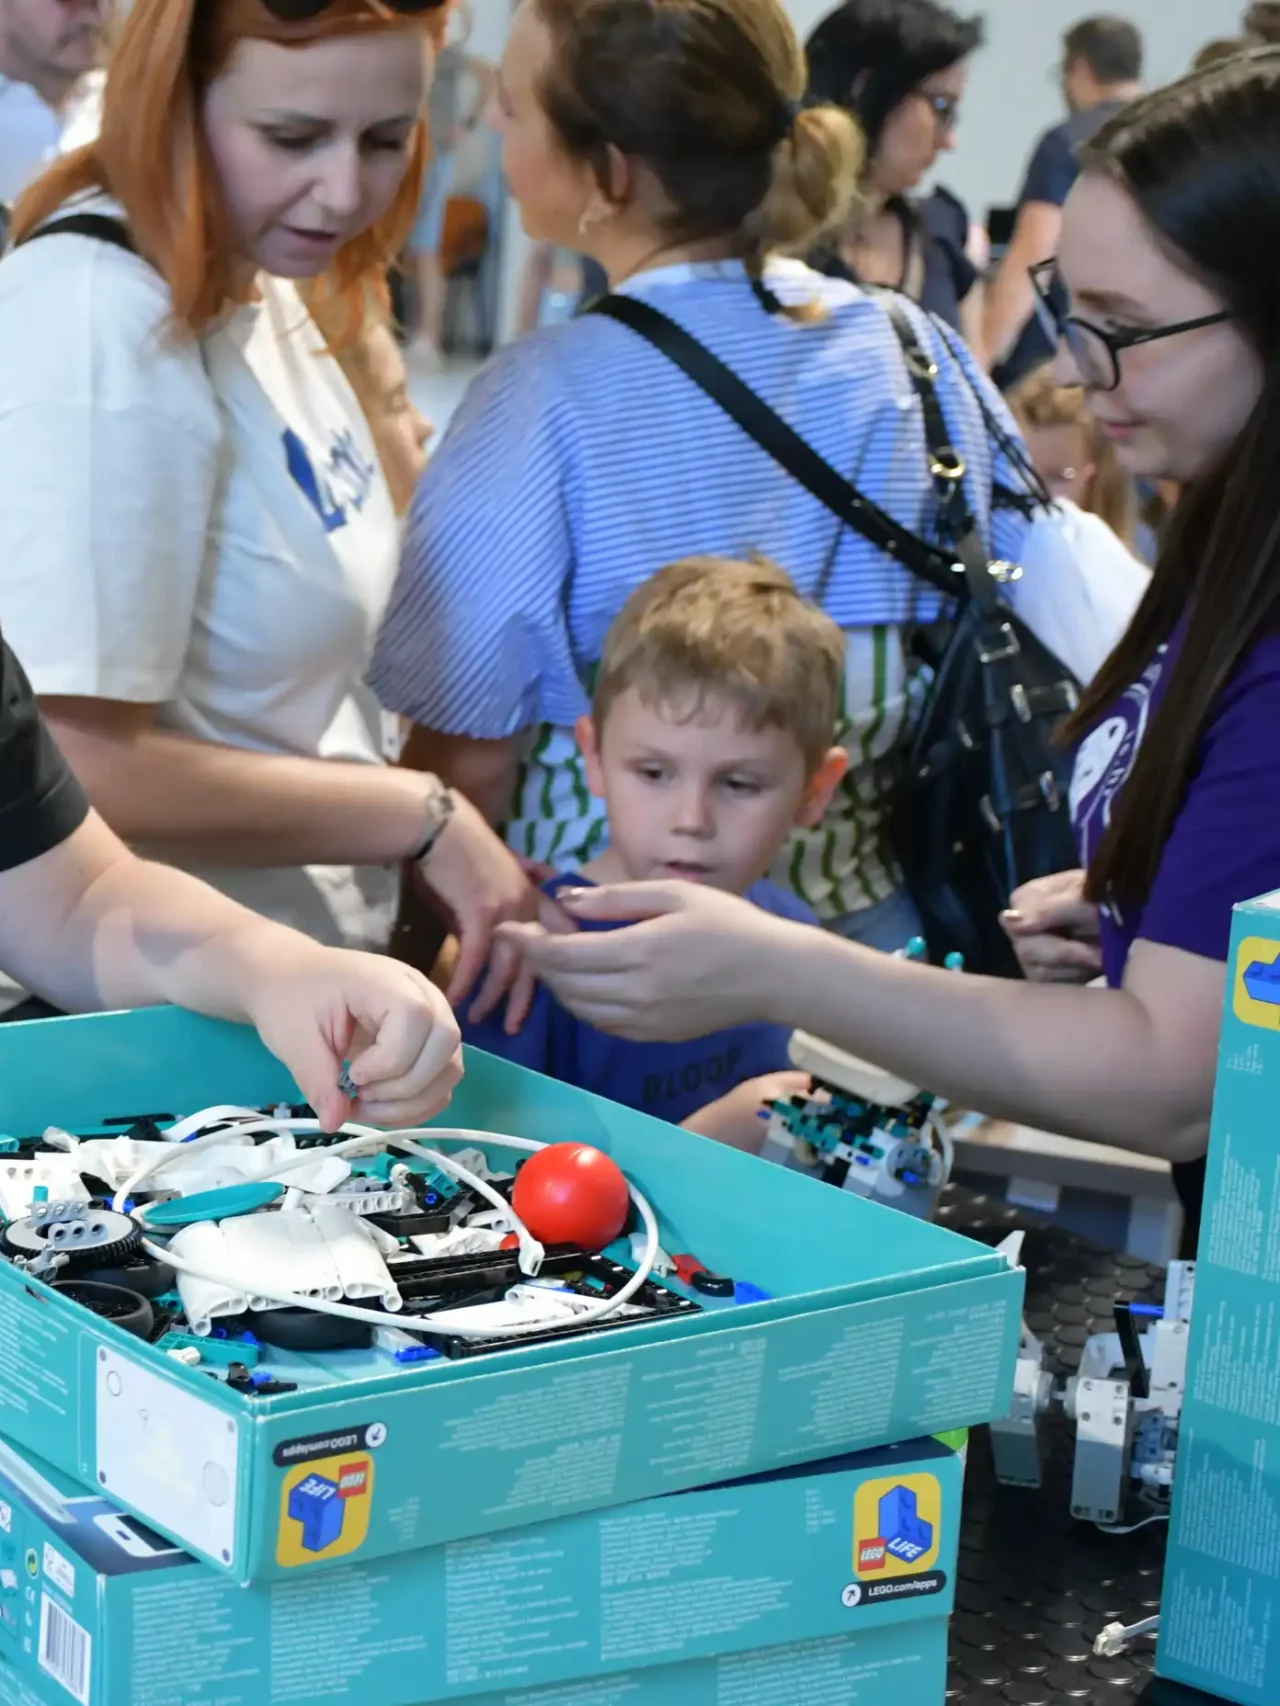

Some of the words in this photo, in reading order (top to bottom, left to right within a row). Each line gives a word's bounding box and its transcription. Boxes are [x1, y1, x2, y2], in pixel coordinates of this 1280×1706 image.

[282, 1434, 357, 1457] LEGO.com/apps
[299, 1478, 336, 1500] LIFE
[860, 1546, 885, 1562] LEGO
[887, 1537, 923, 1558] LIFE
[868, 1579, 938, 1597] LEGO.com/apps
